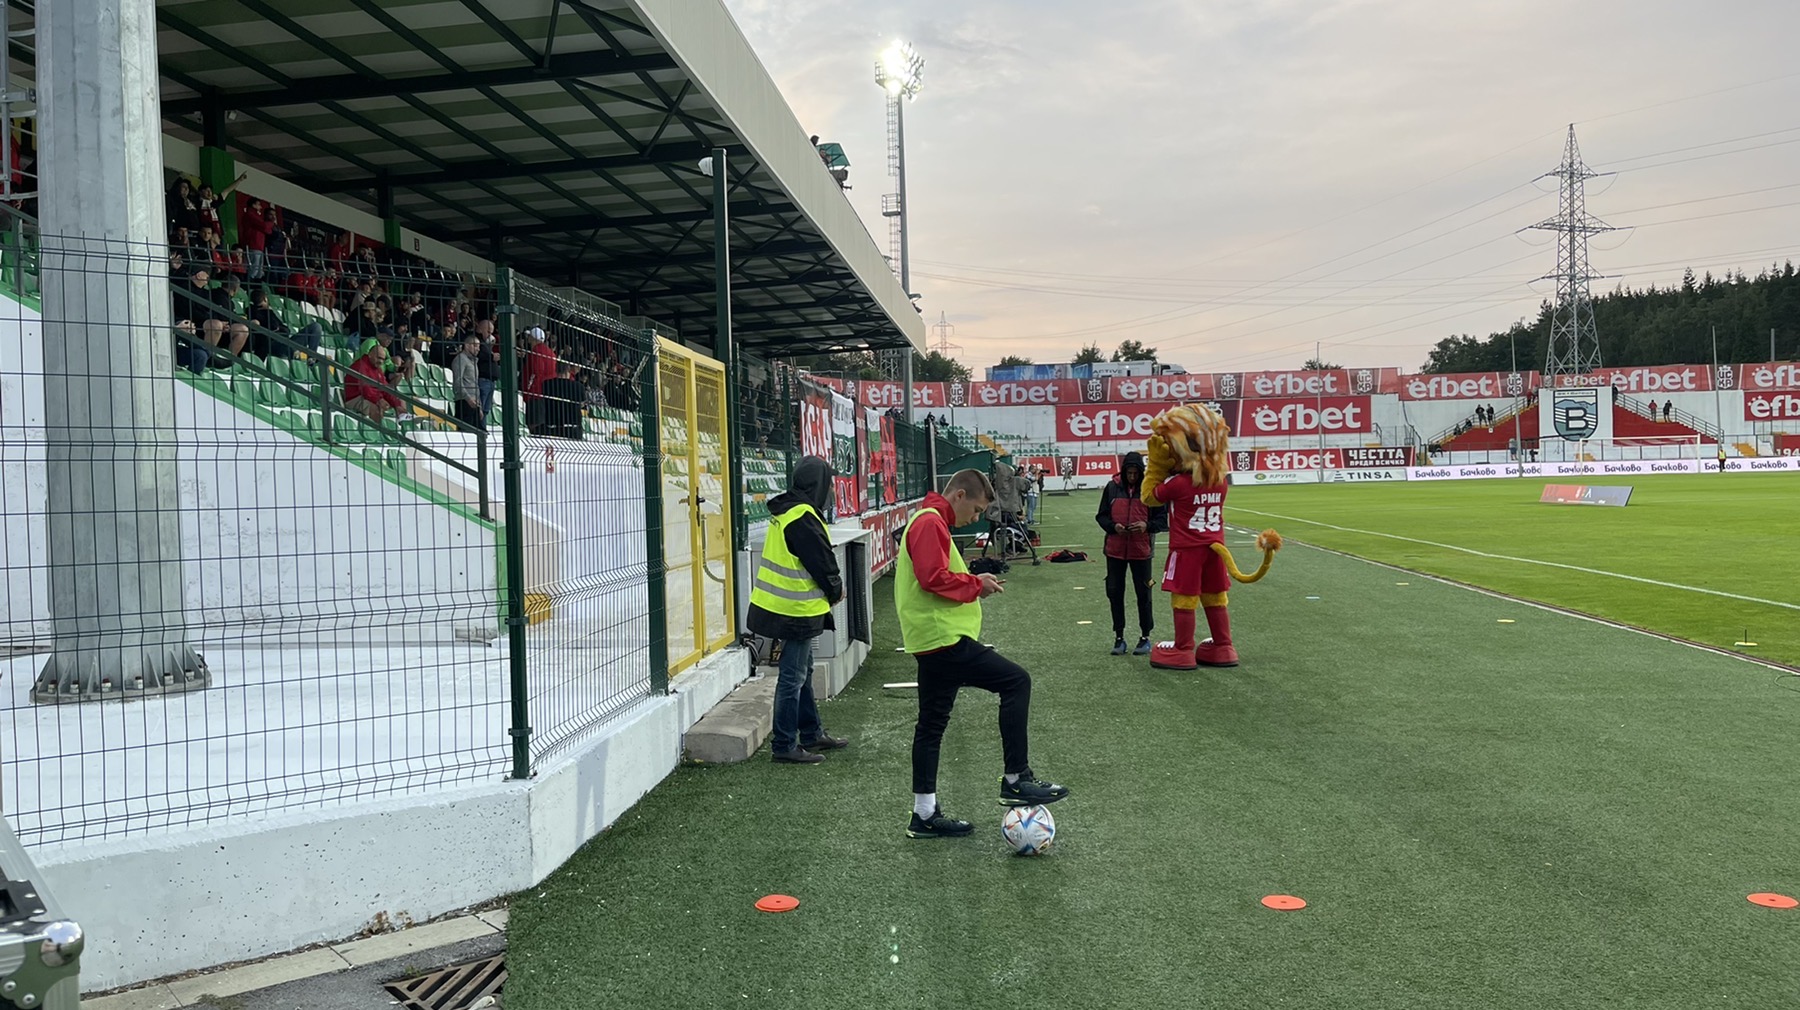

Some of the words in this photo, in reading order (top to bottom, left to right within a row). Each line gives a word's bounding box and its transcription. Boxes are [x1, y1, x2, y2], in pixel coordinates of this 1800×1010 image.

[1255, 372, 1337, 395] efbet
[1563, 375, 1605, 386] efbet
[1610, 368, 1696, 392] efbet
[981, 382, 1059, 404] efbet
[1120, 377, 1201, 400] efbet
[1409, 376, 1493, 399] efbet
[1255, 402, 1361, 431] efbet
[1348, 449, 1405, 460] ЧЕСТТА
[1085, 461, 1112, 470] 1948
[1266, 451, 1335, 470] efbet
[1750, 460, 1788, 469] Бачково
[1460, 468, 1496, 476] Бачково
[1604, 464, 1641, 473] Бачково
[1650, 463, 1688, 472] Бачково
[1347, 471, 1393, 480] TINSA
[1415, 470, 1451, 478] Бачково
[1193, 493, 1221, 505] АРМИ
[1188, 505, 1221, 533] 48
